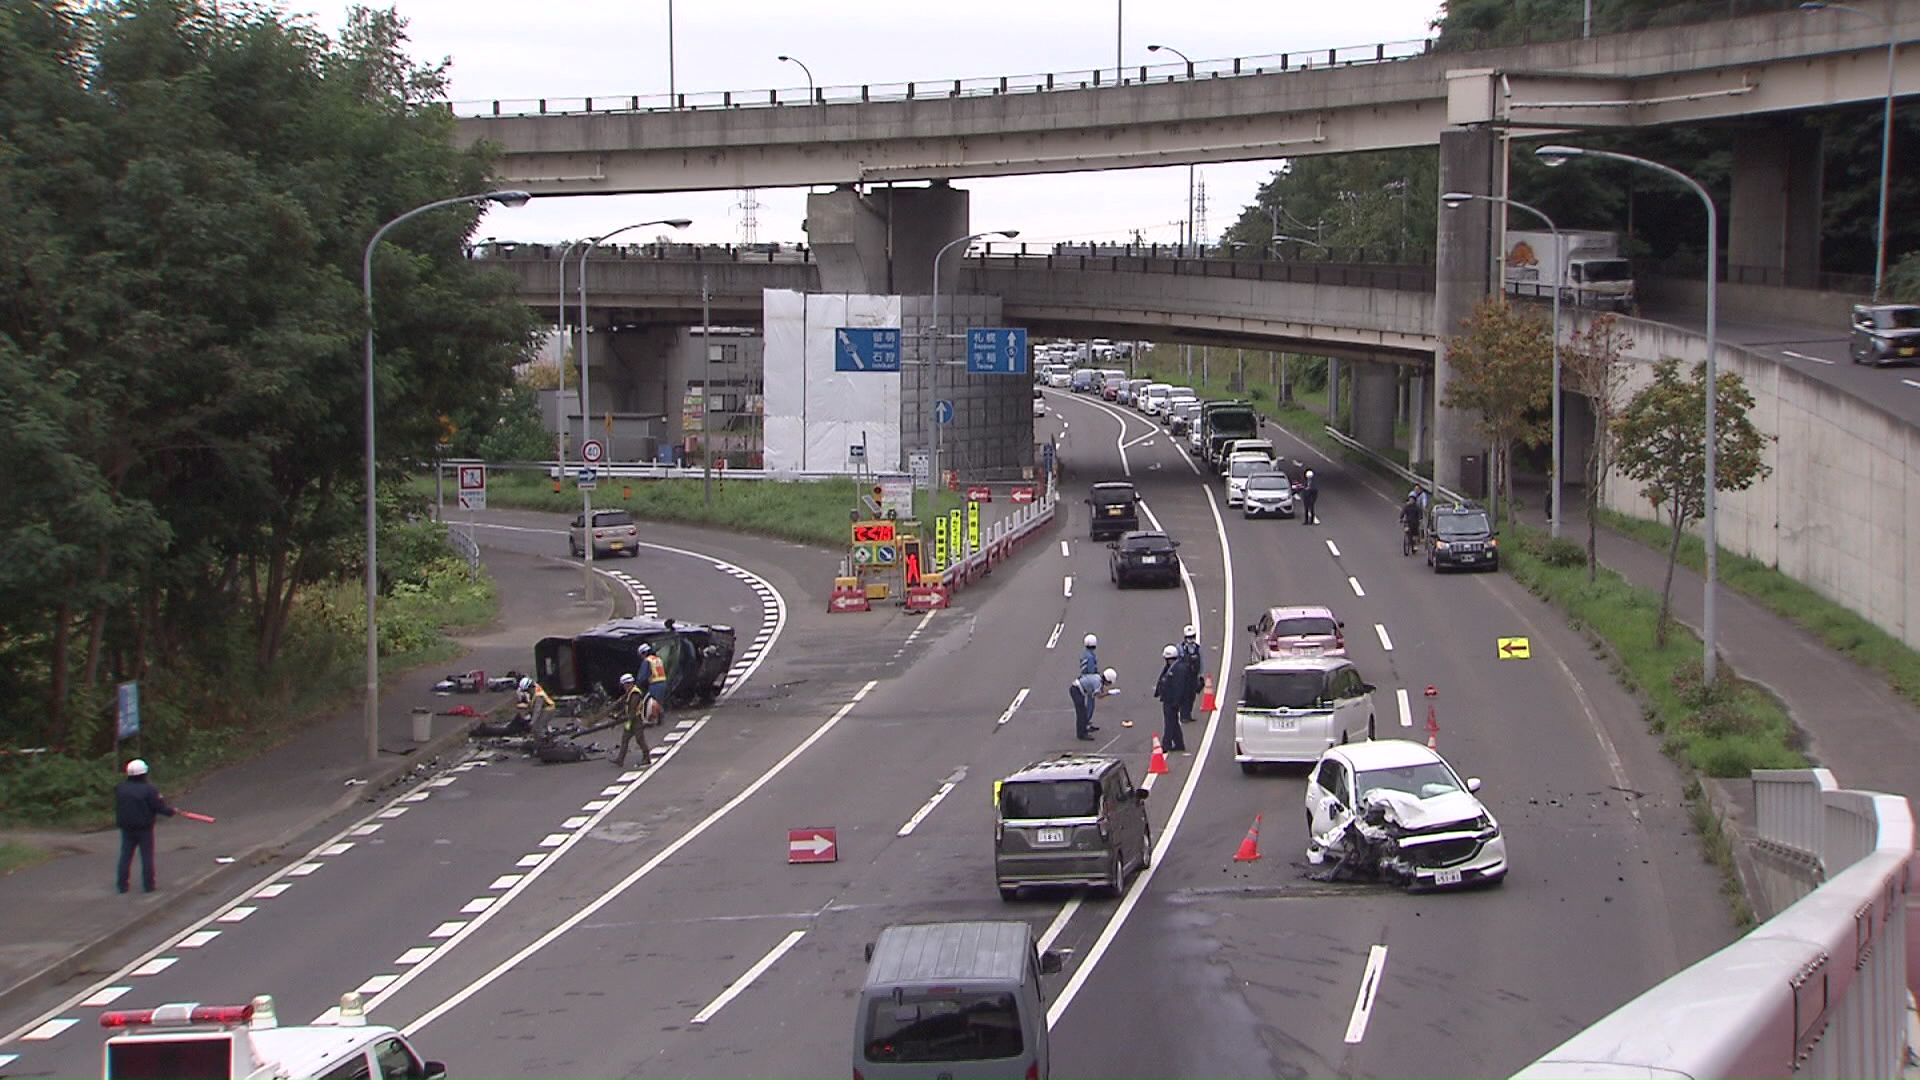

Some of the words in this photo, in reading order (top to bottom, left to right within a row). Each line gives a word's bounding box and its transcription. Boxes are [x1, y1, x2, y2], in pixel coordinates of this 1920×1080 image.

[974, 331, 997, 343] 札幌
[872, 351, 896, 362] 石狩
[974, 352, 997, 363] 手稲
[587, 446, 598, 457] 40
